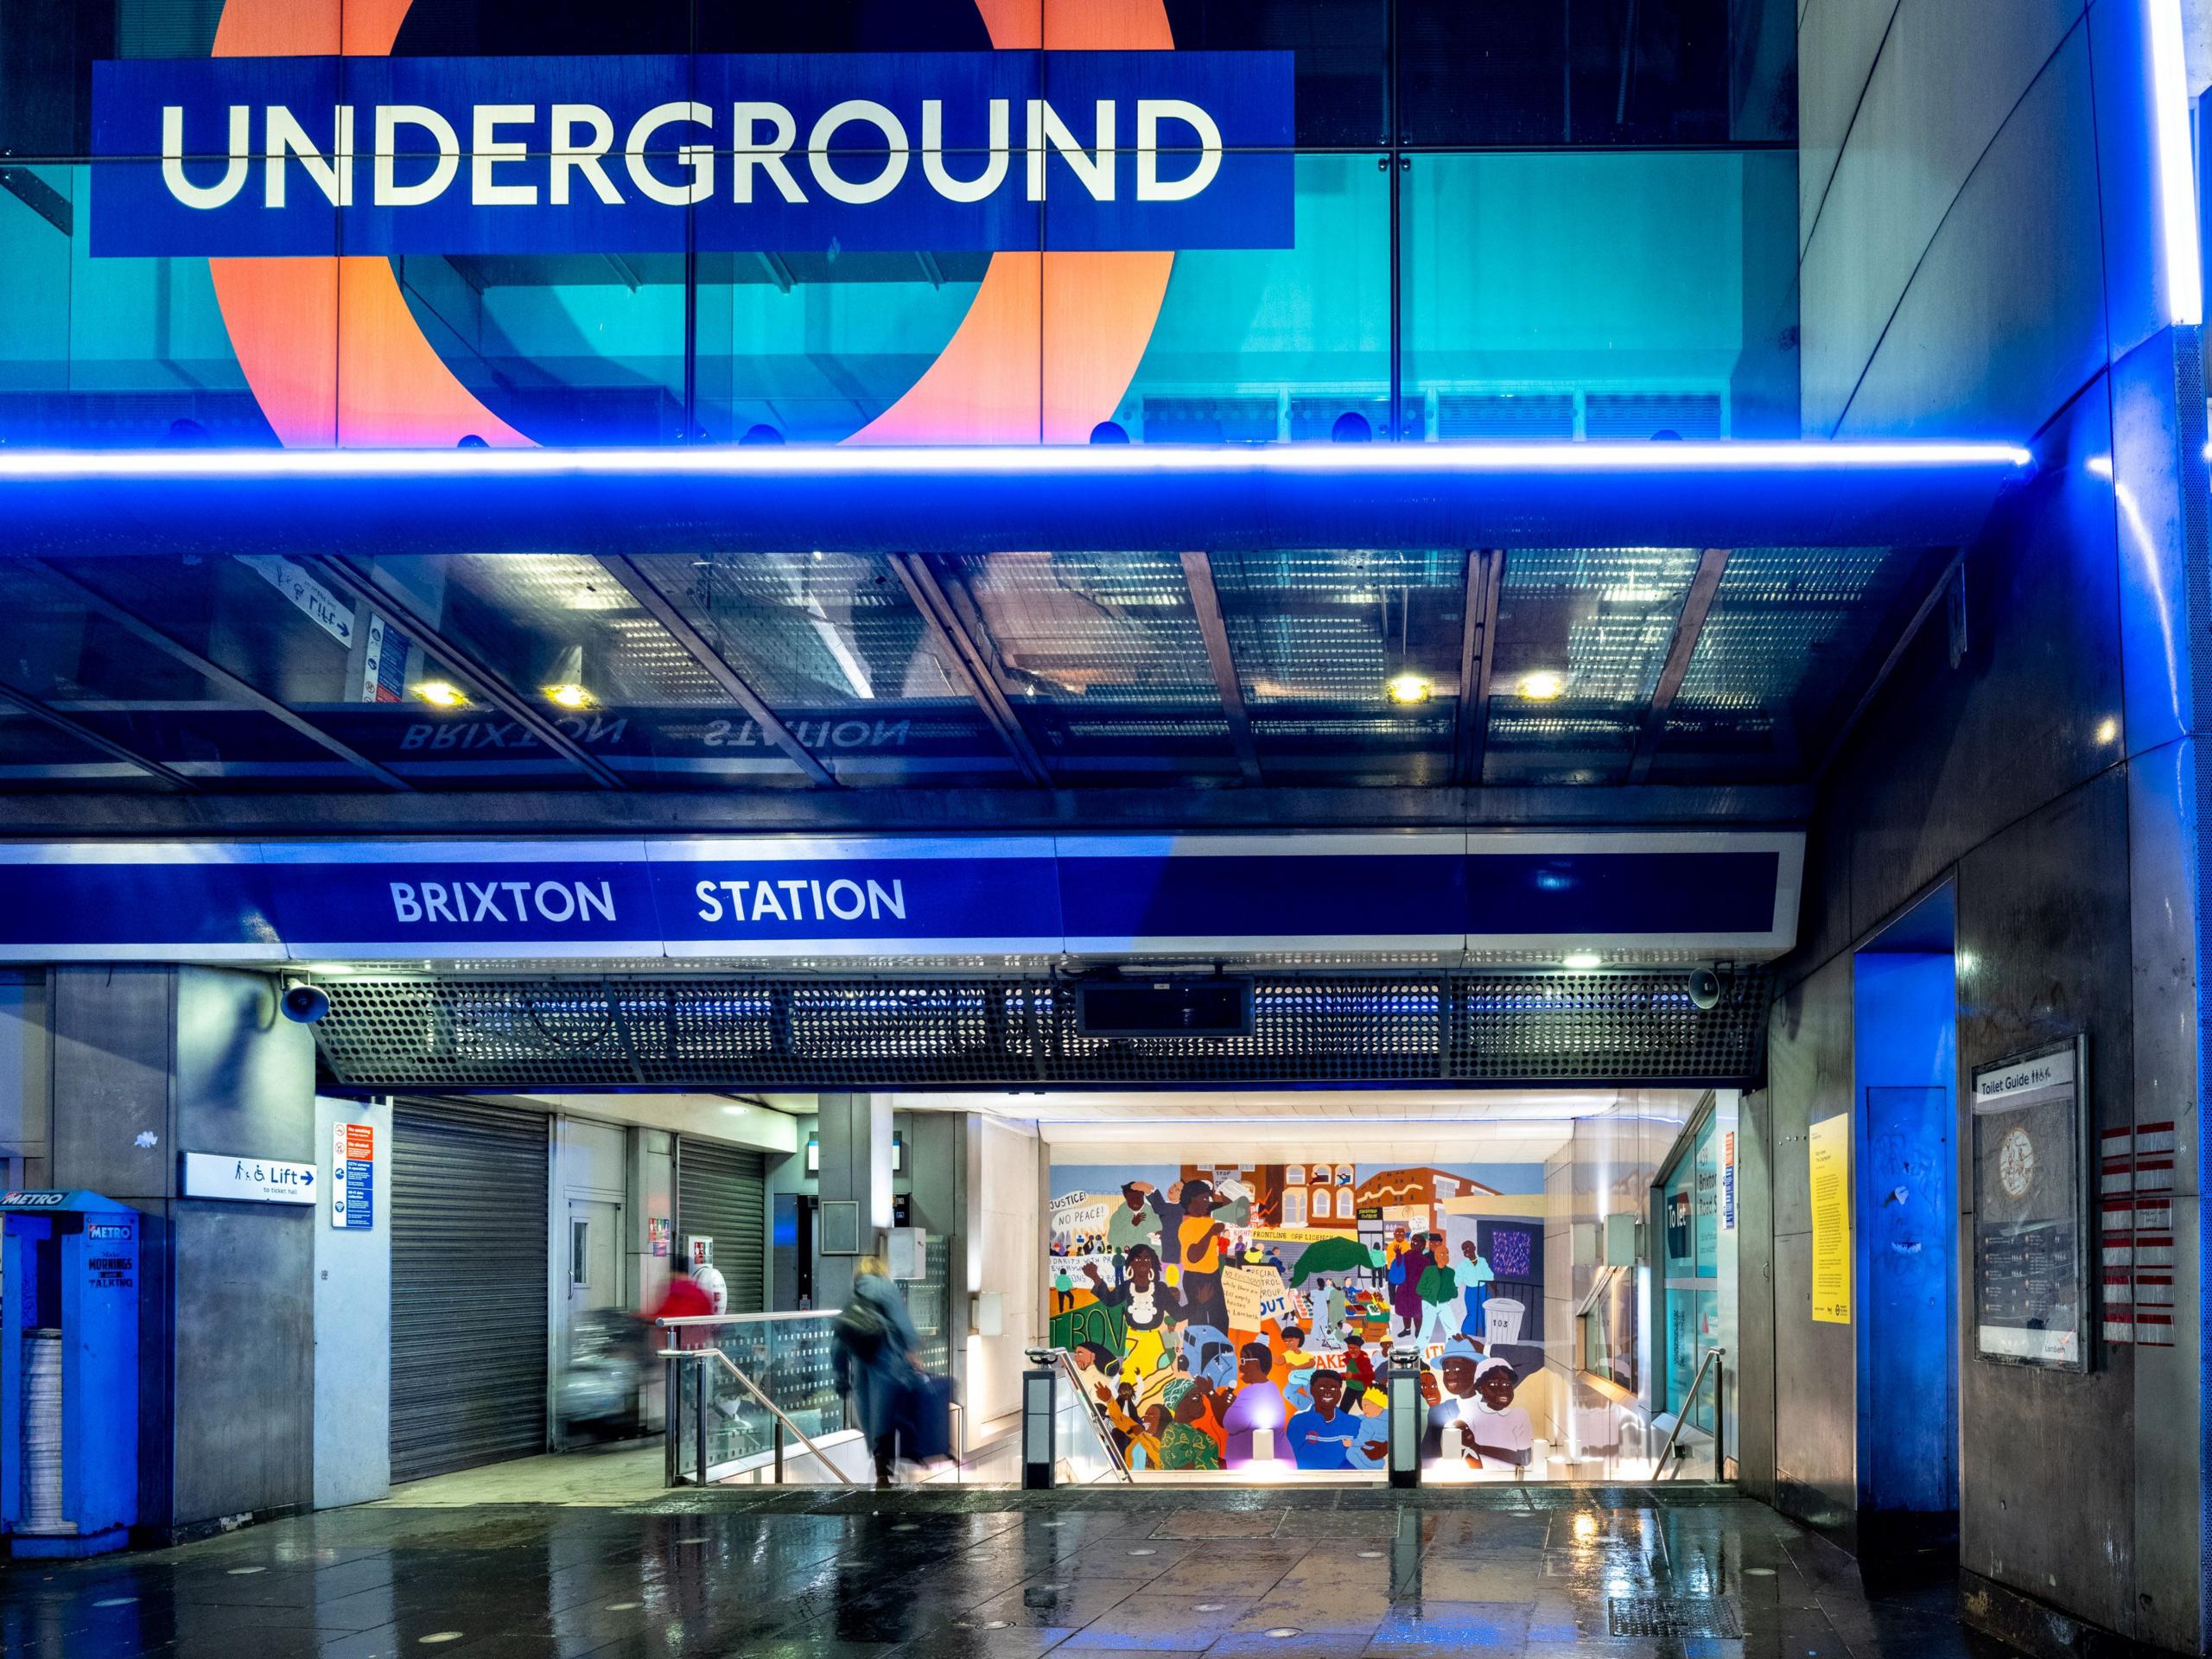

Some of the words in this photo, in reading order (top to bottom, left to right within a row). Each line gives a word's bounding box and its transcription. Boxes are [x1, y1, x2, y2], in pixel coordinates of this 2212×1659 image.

[162, 99, 1222, 209] UNDERGROUND
[391, 881, 616, 922] BRIXTON
[696, 880, 906, 921] STATION
[1981, 1081, 2003, 1096] Toilet
[2005, 1072, 2030, 1090] Guide
[270, 1167, 298, 1185] Lift
[2, 1193, 63, 1205] METRO
[1049, 1192, 1087, 1210] JUSTICE!
[1058, 1216, 1071, 1226] NO
[1074, 1206, 1104, 1223] PEACE!
[1668, 1205, 1675, 1229] To
[1676, 1202, 1687, 1227] let
[91, 1226, 130, 1239] METRO
[1253, 1230, 1287, 1239] FRONTLINE
[88, 1257, 132, 1271] MORNINGS
[88, 1278, 133, 1288] TALKING
[1233, 1309, 1259, 1320] Lambeth
[1261, 1297, 1285, 1316] OUT
[1492, 1319, 1509, 1328] 103
[1313, 1353, 1347, 1370] AKE
